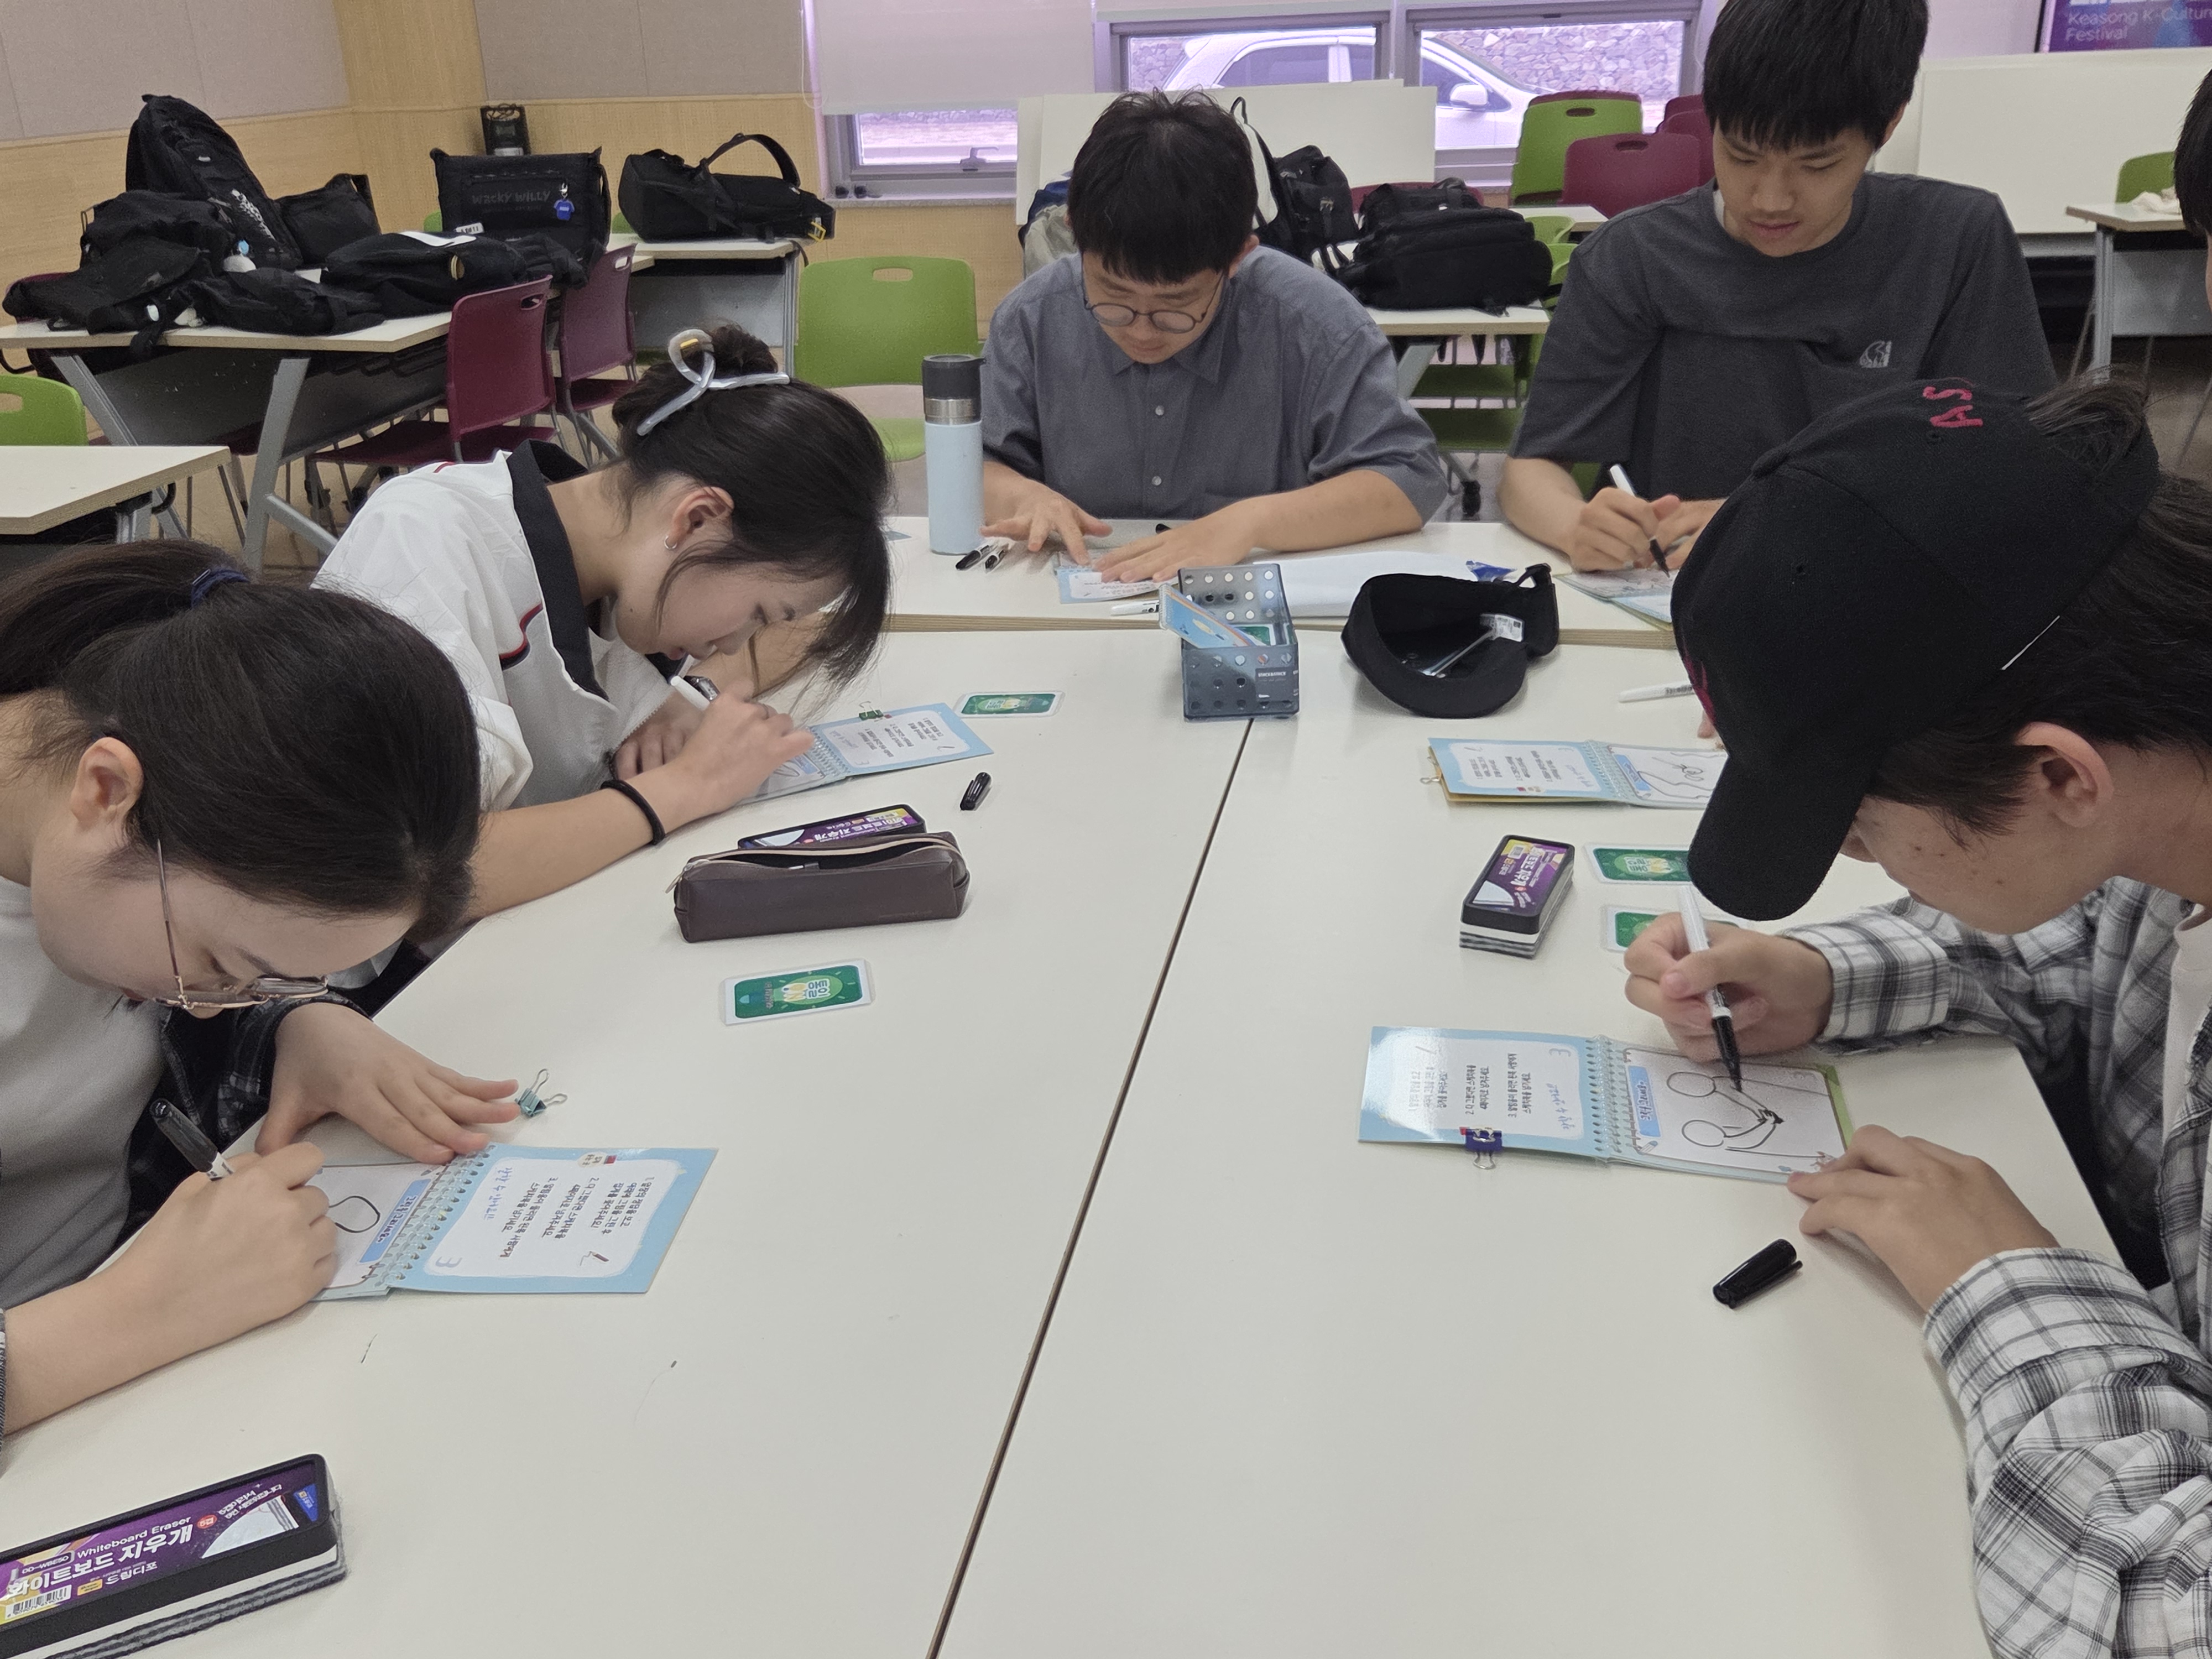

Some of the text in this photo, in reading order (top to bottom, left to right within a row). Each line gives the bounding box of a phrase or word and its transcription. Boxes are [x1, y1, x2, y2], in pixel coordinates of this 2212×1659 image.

[2068, 12, 2138, 27] Keasong
[2066, 28, 2128, 41] Festival
[515, 190, 550, 202] WILLY
[807, 978, 831, 999] 통일
[619, 1215, 633, 1227] 보고
[435, 1256, 462, 1267] 3
[77, 1515, 192, 1557] Whiteboard Eraser
[7, 1552, 115, 1597] 화이트보드
[118, 1524, 194, 1563] 지우개
[105, 1561, 158, 1585] 드림디포
